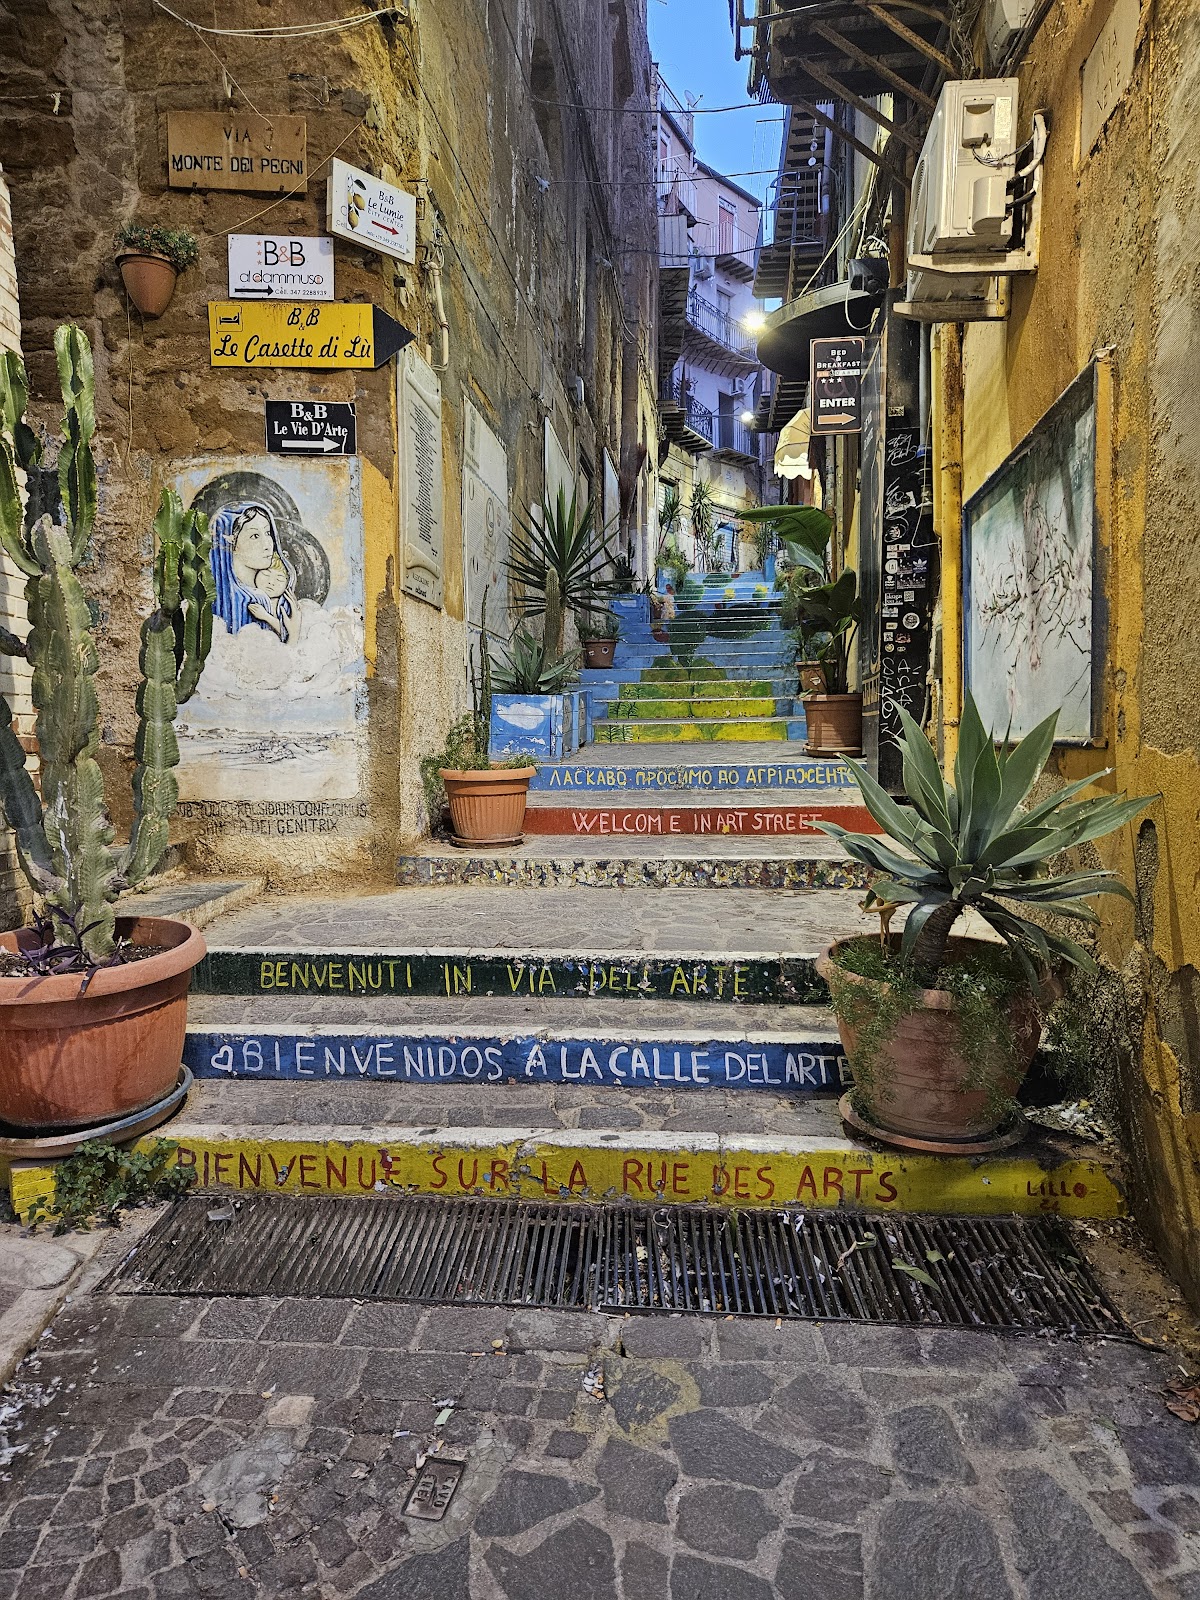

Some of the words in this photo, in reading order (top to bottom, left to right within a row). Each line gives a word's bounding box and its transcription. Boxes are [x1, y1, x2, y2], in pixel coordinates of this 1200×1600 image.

[223, 127, 252, 143] VIA
[171, 154, 223, 172] MONTE
[230, 156, 254, 173] DEI
[261, 158, 304, 175] PEGNI
[367, 197, 378, 210] Le
[264, 240, 306, 267] B&B
[239, 270, 251, 283] al
[252, 269, 324, 285] dammuso
[287, 307, 321, 331] B&B
[213, 334, 239, 357] Le
[243, 334, 314, 363] Casette
[317, 336, 340, 358] di
[343, 335, 371, 358] Lù
[830, 349, 847, 357] BED
[816, 361, 861, 369] BREAKFAST
[290, 402, 328, 421] B&B
[819, 397, 856, 408] ENTER
[273, 420, 288, 435] Le
[290, 421, 309, 436] Vie
[311, 421, 348, 437] D'Arte
[549, 769, 628, 787] ЛАСКАВО
[276, 818, 339, 836] GENITRIX
[571, 811, 681, 834] WELCOME
[693, 813, 711, 833] IN
[716, 811, 749, 833] ART
[751, 812, 823, 833] STREET
[260, 959, 413, 992] BENVENUTI
[444, 962, 473, 997] IN
[506, 963, 557, 993] VIA
[669, 964, 750, 996] ARTE
[242, 1039, 503, 1082] BIENVENIDOS
[524, 1043, 548, 1077] A
[560, 1045, 604, 1080] LA
[608, 1045, 711, 1084] CALLE
[724, 1051, 782, 1085] DEL
[785, 1051, 856, 1087] ARTE
[176, 1146, 402, 1191] BIENVENUE
[428, 1152, 510, 1190] SUR
[541, 1158, 589, 1196] LA
[622, 1157, 691, 1196] RUE
[712, 1163, 776, 1200] DES
[796, 1164, 898, 1203] ARTS
[1026, 1180, 1088, 1199] LILLO
